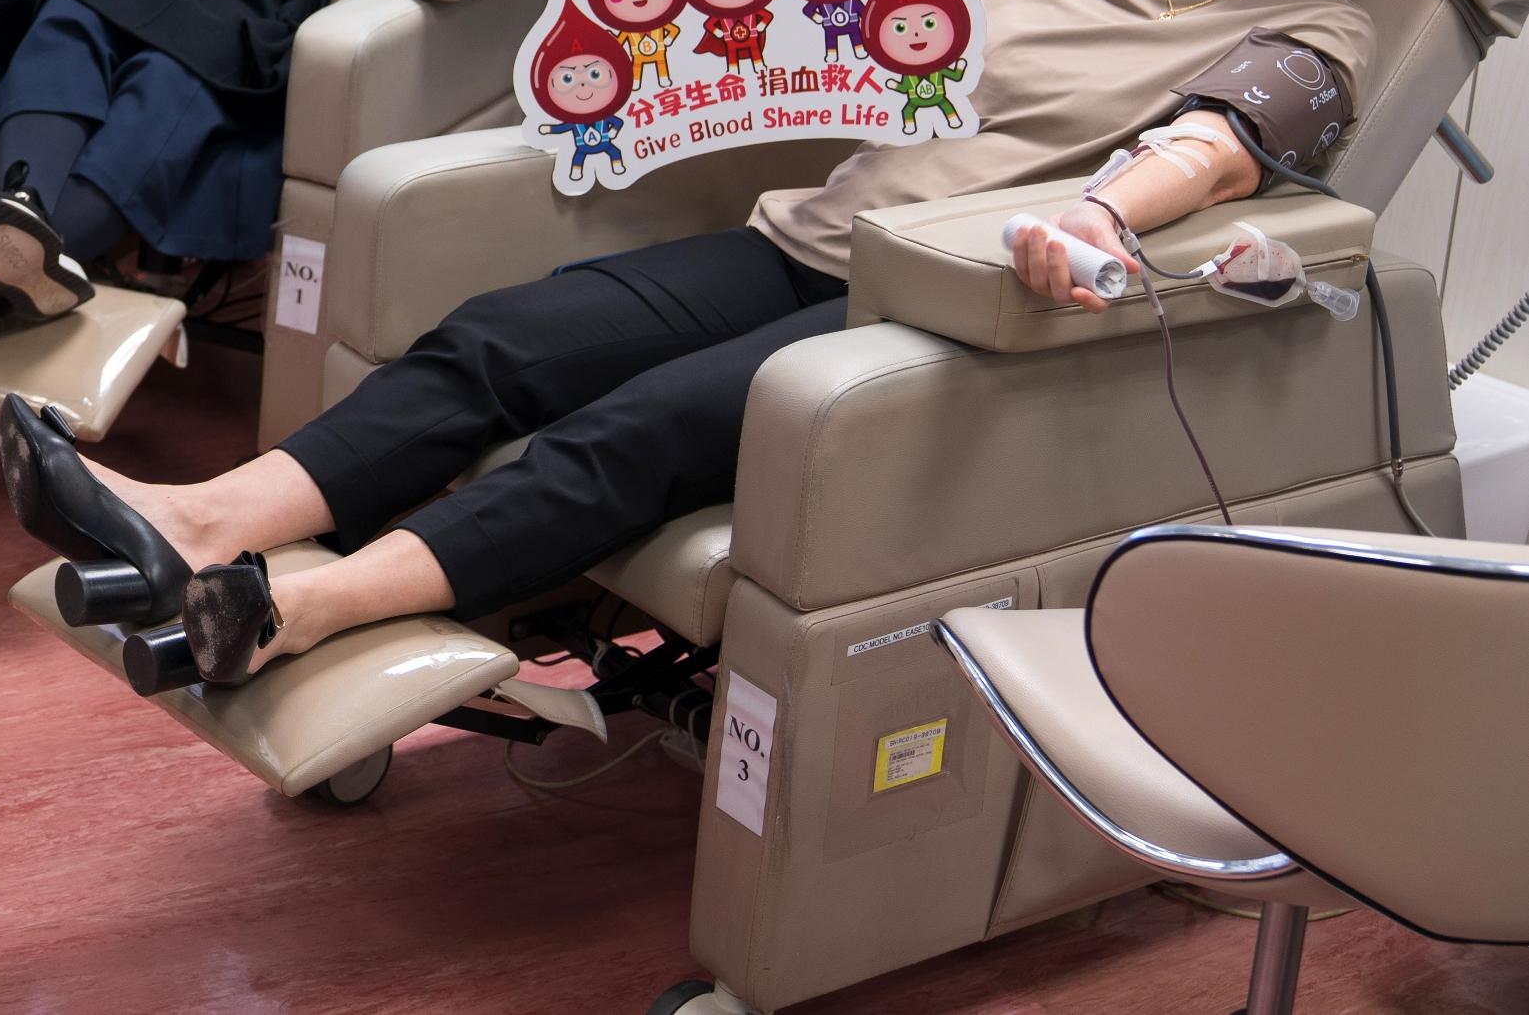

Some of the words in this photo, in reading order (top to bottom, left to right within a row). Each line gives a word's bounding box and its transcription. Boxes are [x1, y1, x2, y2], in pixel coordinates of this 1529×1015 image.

[834, 11, 846, 24] O
[572, 39, 584, 53] A
[643, 41, 653, 52] B
[626, 72, 747, 129] 分享生命
[758, 63, 885, 96] 捐血救人
[919, 84, 933, 96] AB
[1309, 86, 1338, 111] 27-35cm
[587, 130, 598, 143] A
[633, 134, 681, 160] Give
[688, 111, 753, 143] Blood
[763, 107, 833, 129] Share
[841, 103, 889, 127] Life
[284, 260, 318, 284] NO.
[295, 288, 303, 305] 1
[869, 636, 891, 648] MODEL
[727, 714, 766, 759] NO.
[737, 758, 750, 782] 3
